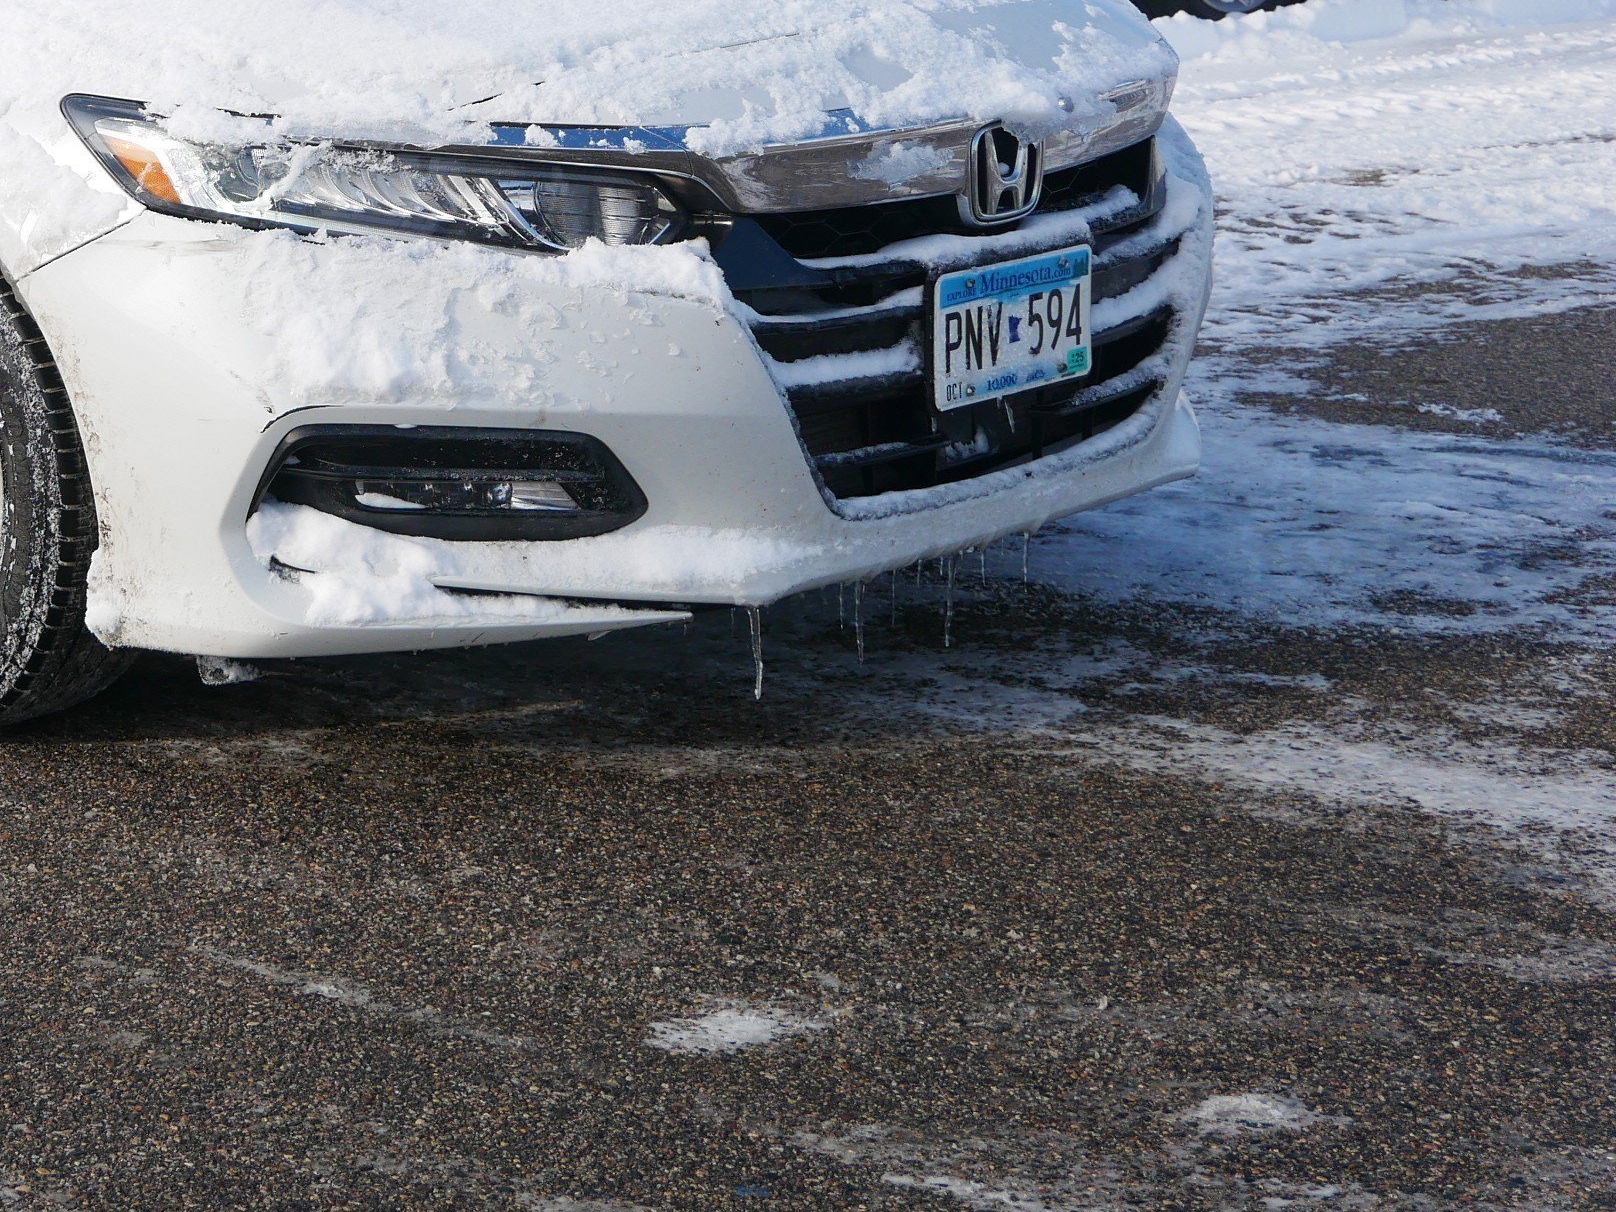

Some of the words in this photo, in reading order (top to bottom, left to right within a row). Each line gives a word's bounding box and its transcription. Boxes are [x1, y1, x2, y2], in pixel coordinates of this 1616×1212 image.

[946, 287, 978, 303] EXPLORE
[945, 301, 1003, 374] PNV
[1028, 283, 1082, 355] 594
[946, 382, 963, 402] OCT
